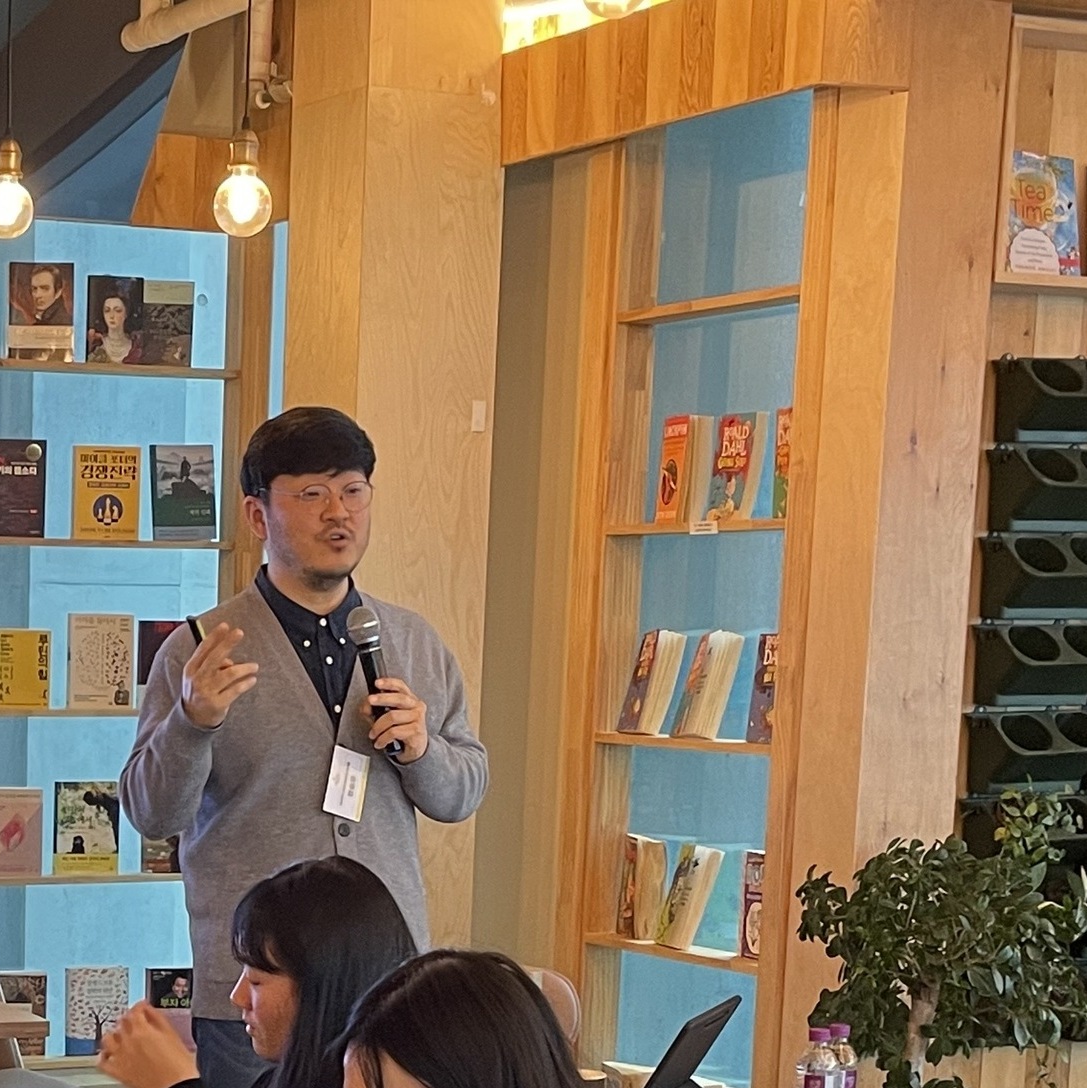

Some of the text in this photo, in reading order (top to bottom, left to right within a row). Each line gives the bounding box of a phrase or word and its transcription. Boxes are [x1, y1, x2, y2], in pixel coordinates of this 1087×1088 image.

[1016, 178, 1047, 201] Tea
[1010, 198, 1054, 223] Time
[723, 425, 750, 441] ROALD
[721, 440, 747, 457] DAHL
[80, 453, 107, 464] 마이클
[81, 465, 138, 480] 경쟁전략
